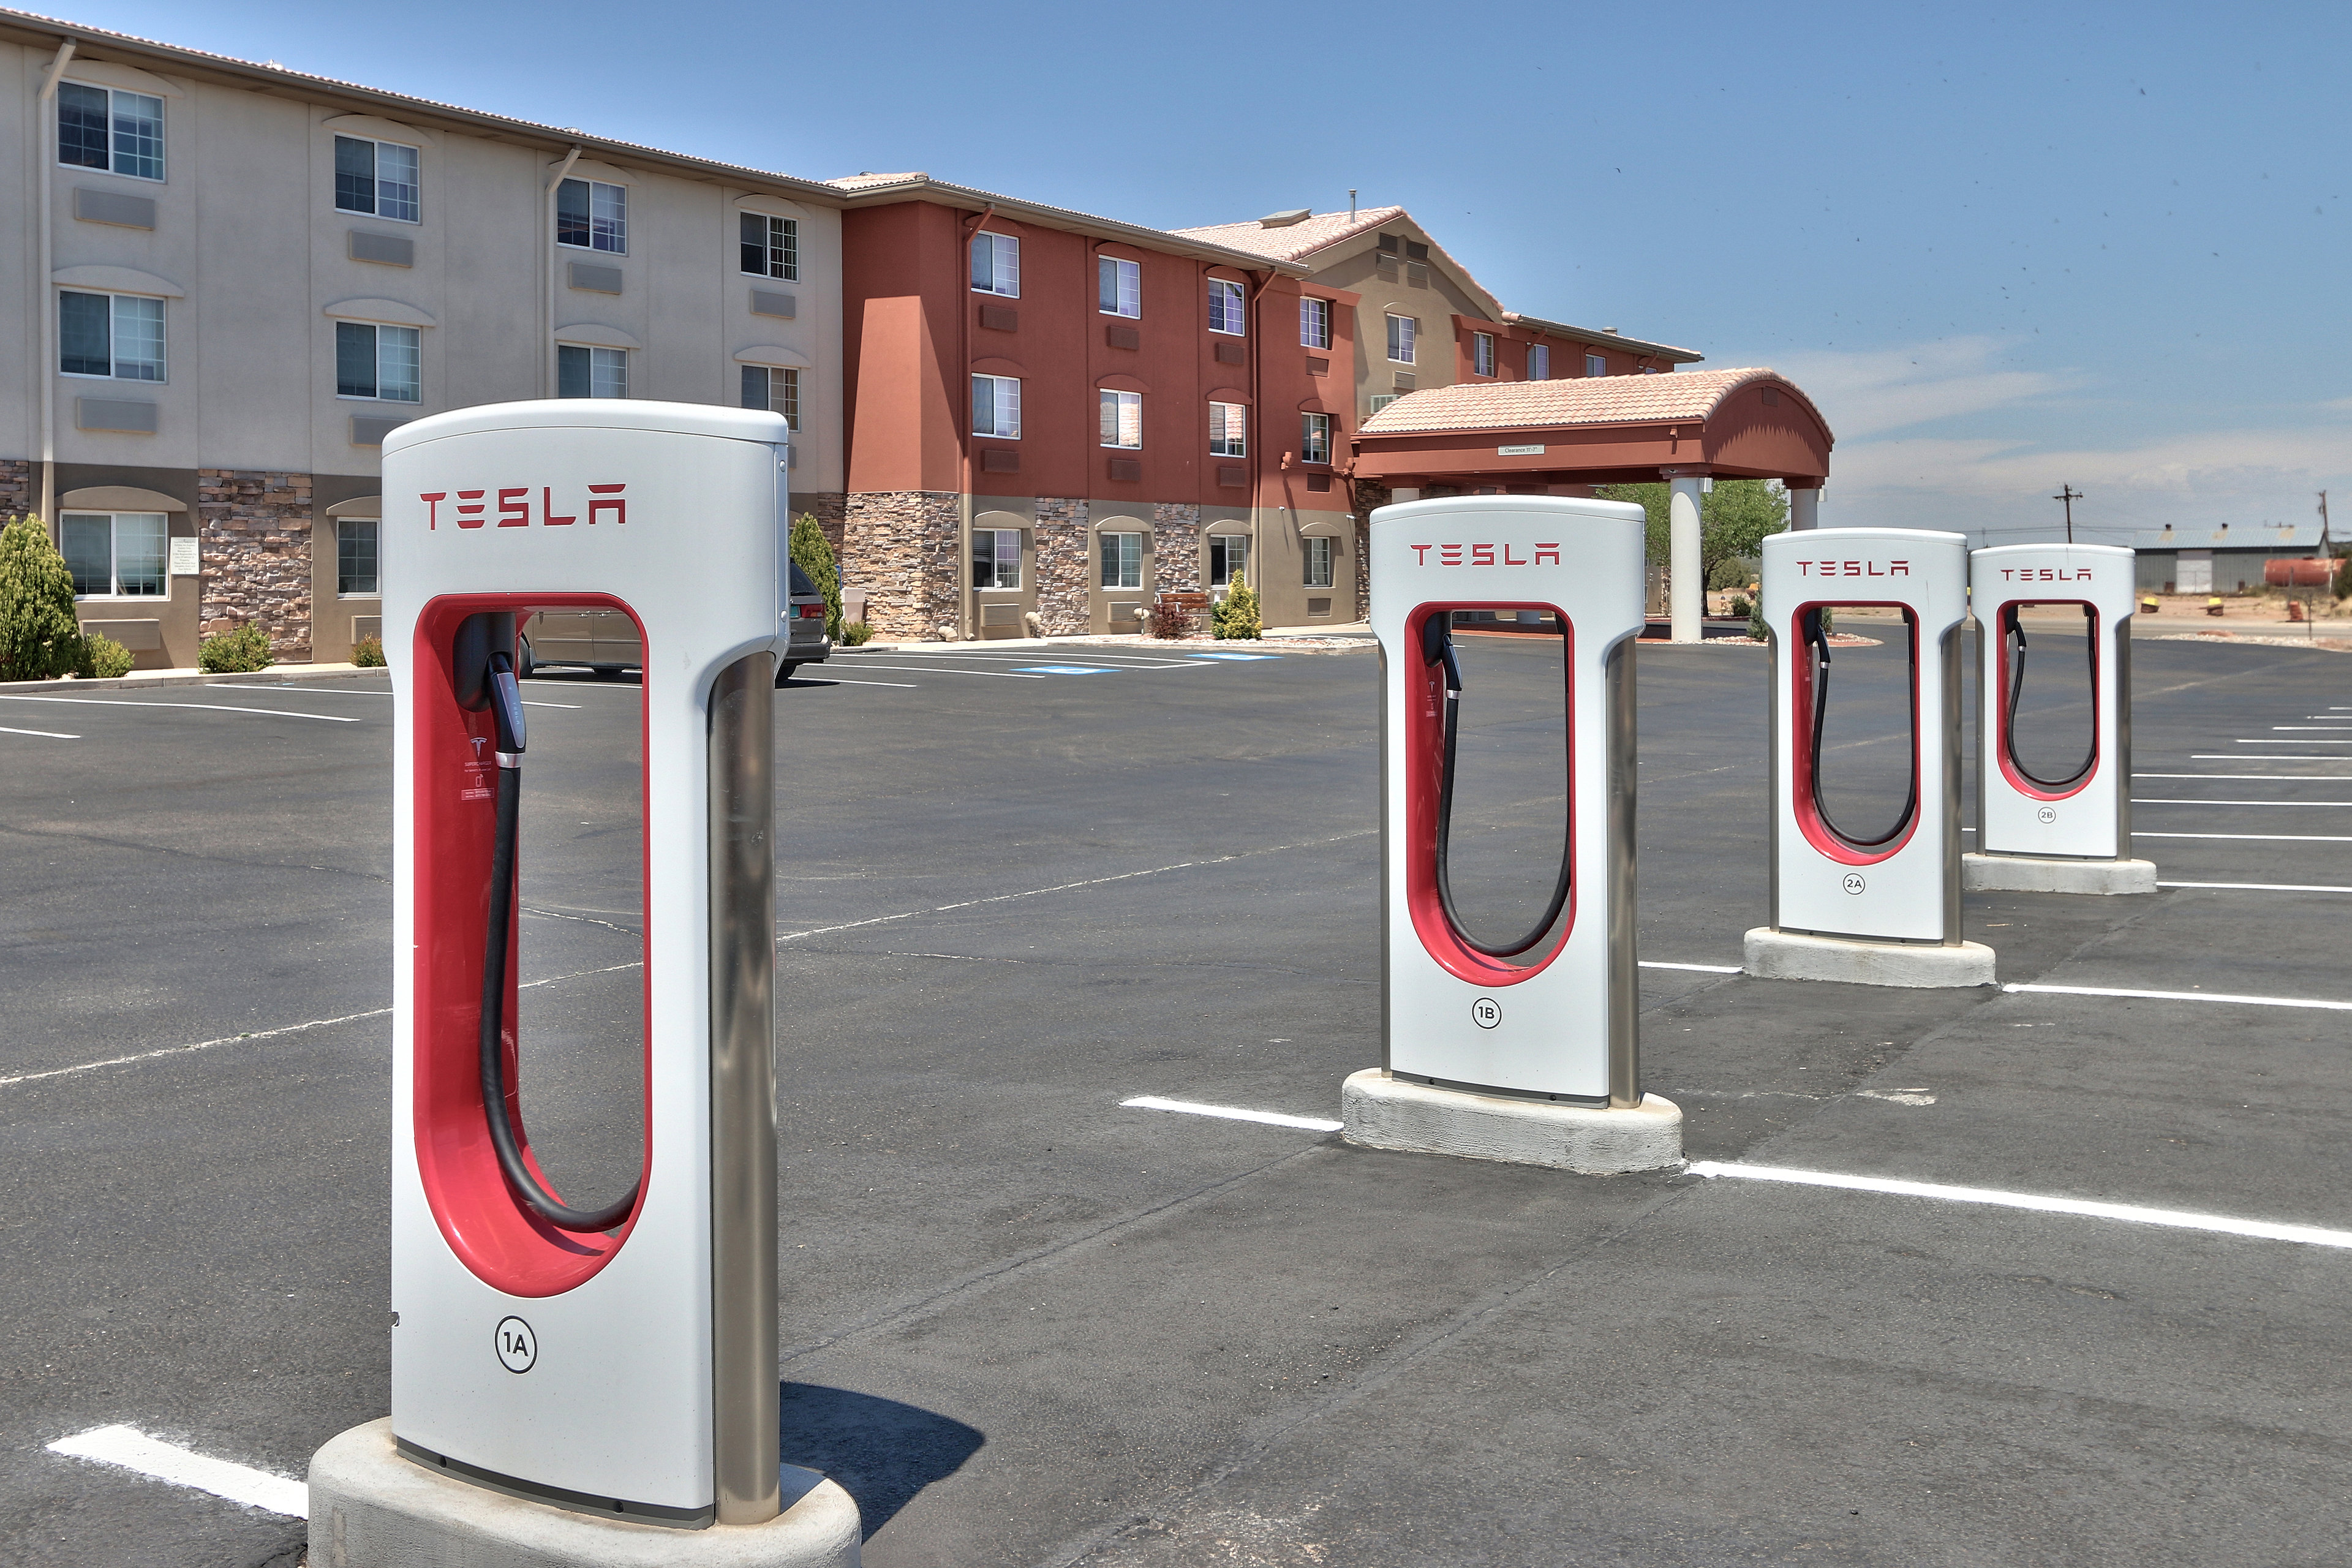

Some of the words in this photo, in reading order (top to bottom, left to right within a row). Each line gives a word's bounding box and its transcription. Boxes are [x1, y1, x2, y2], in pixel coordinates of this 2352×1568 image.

[420, 484, 626, 530] TESLA
[1411, 543, 1559, 566] TESLA
[1796, 560, 1909, 576] TESLA
[2001, 568, 2092, 581] TESLA
[1847, 879, 1862, 888] 2A
[1478, 1006, 1495, 1019] 1B
[503, 1332, 529, 1358] 1A
